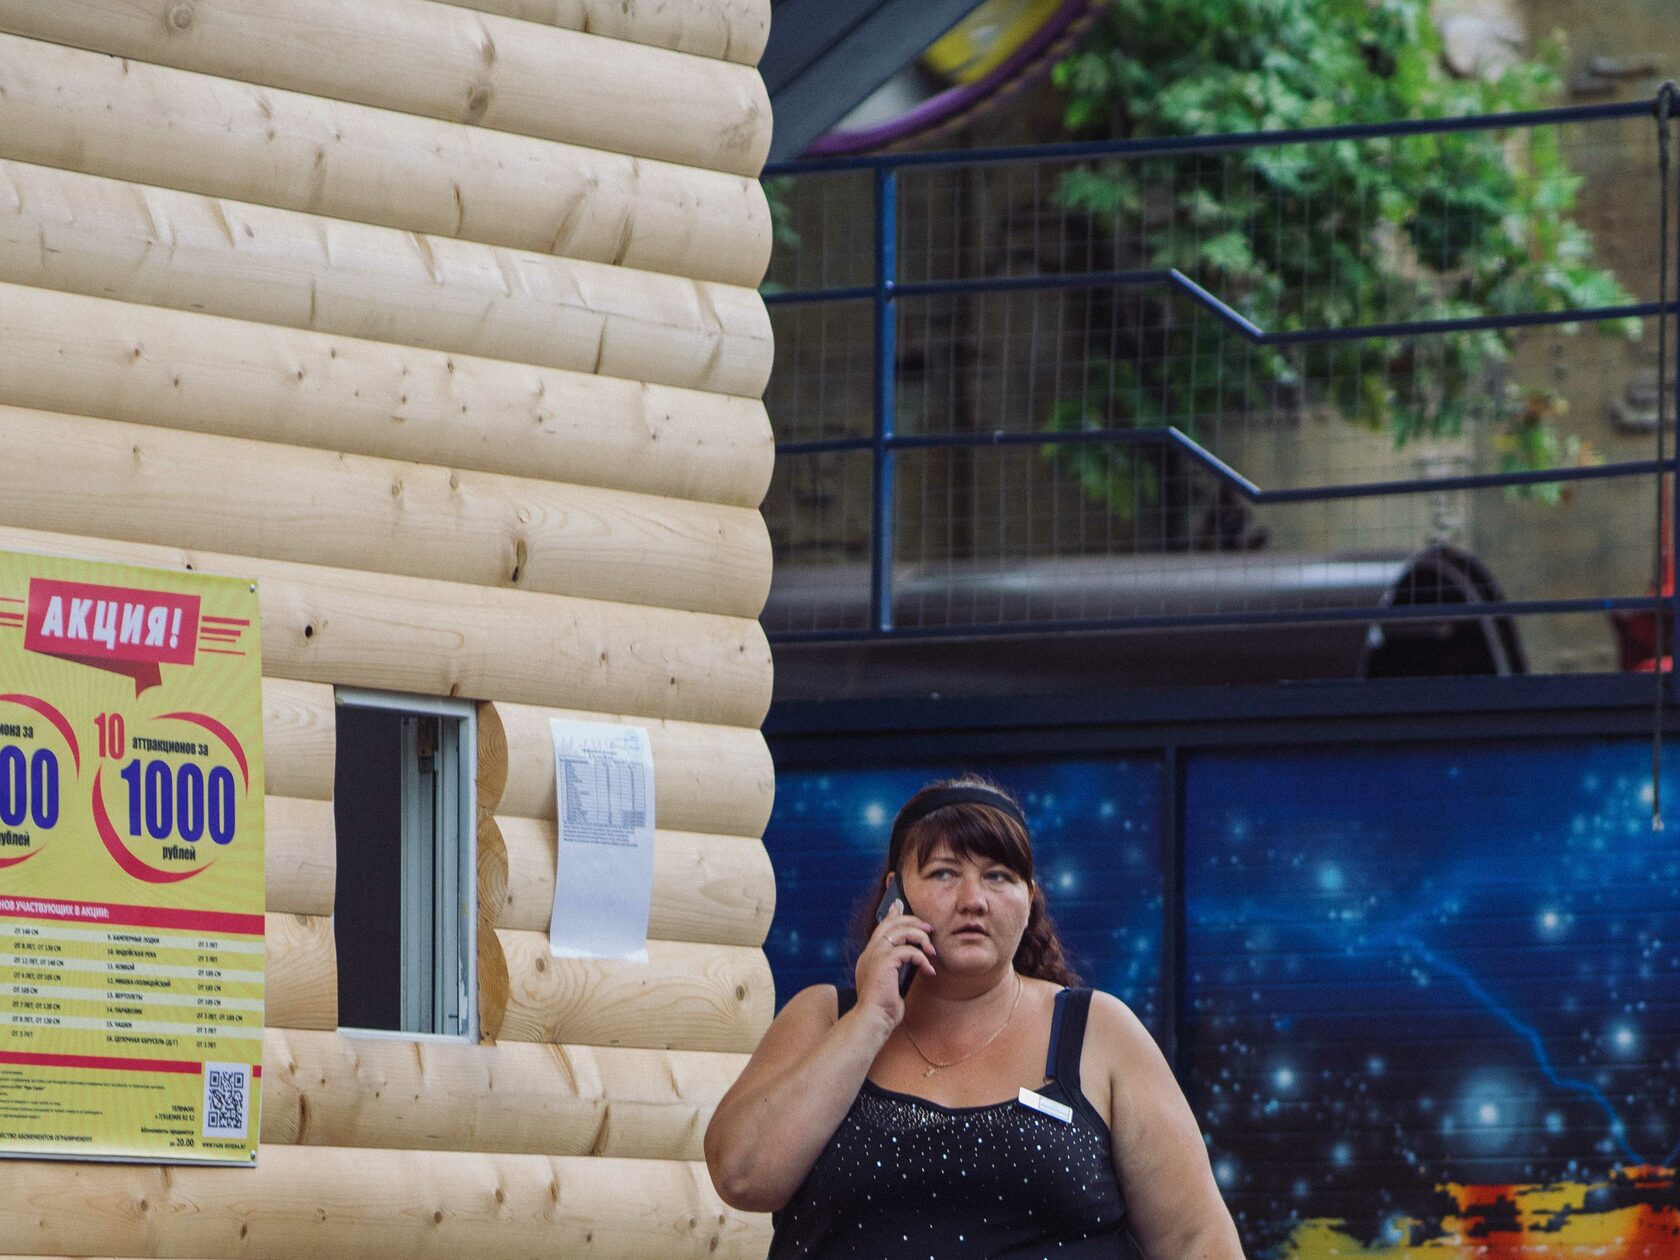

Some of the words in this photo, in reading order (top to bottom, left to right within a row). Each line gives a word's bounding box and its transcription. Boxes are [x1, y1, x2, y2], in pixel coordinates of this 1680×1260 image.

[41, 595, 183, 650] АКЦИЯ!
[23, 726, 34, 738] за
[93, 712, 125, 760] 10
[132, 737, 196, 755] аттракционов
[198, 744, 209, 756] за
[121, 759, 236, 845] 1000
[162, 845, 196, 861] рублей
[16, 901, 73, 916] УЧАСТВУЮЩИХ
[74, 906, 80, 916] В
